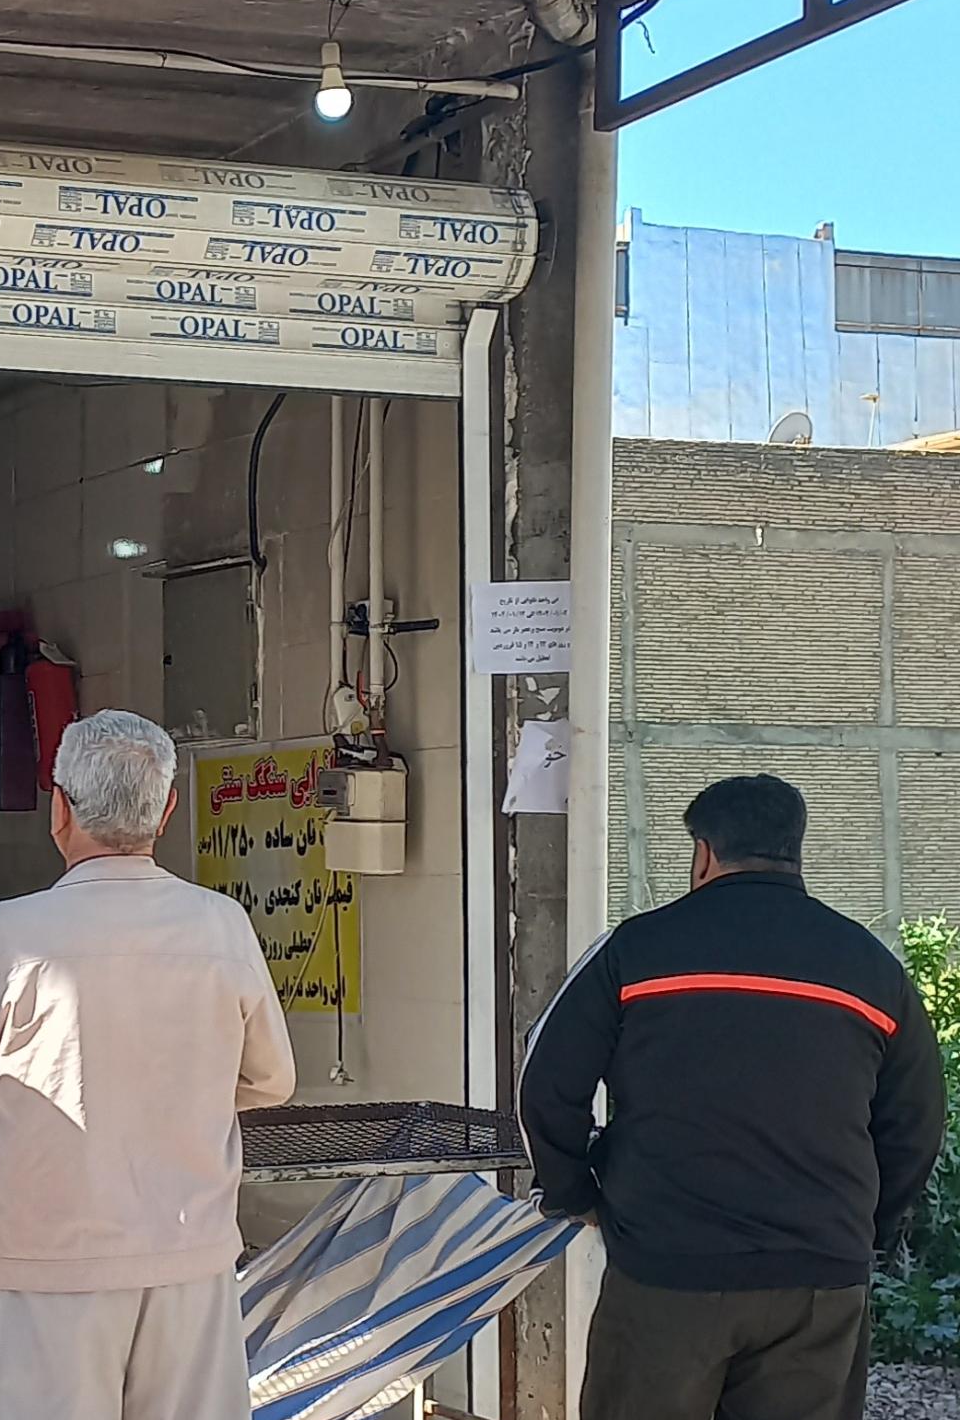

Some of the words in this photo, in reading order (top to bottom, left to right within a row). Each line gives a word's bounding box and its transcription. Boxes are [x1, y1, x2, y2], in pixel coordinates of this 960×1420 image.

[20, 154, 93, 174] OPAL
[194, 167, 265, 189] OPAL
[362, 182, 430, 203] OPAL
[96, 194, 167, 219] OPAL
[267, 208, 335, 232] OPAL
[70, 230, 141, 253] OPAL
[432, 221, 499, 245] OPAL
[241, 243, 309, 267] OPAL
[406, 257, 471, 279] OPAL
[156, 280, 223, 303] OPAL
[12, 304, 81, 327] OPAL
[317, 293, 381, 315] OPAL
[180, 316, 246, 339] OPAL
[341, 328, 404, 349] OPAL
[211, 766, 242, 815] سنتی
[212, 824, 254, 859] ۱۱/۲۵۰
[265, 816, 292, 848] ساده
[296, 818, 316, 856] نان
[264, 879, 301, 915] کنجدی
[305, 878, 321, 914] نان
